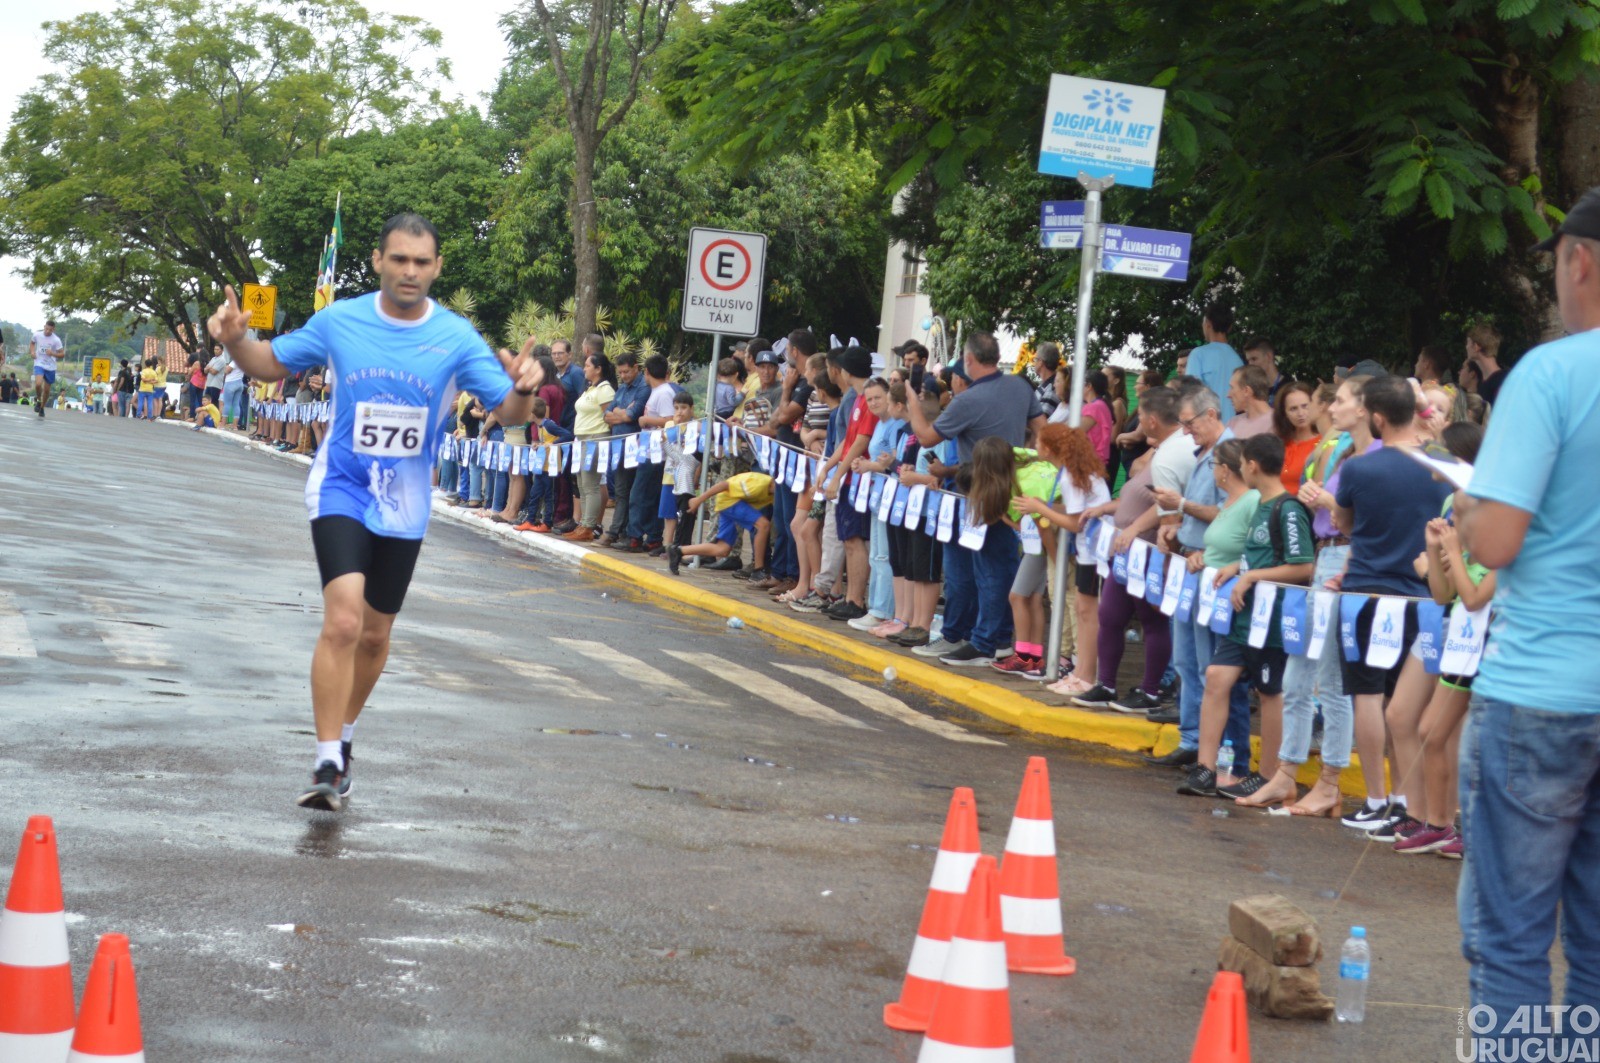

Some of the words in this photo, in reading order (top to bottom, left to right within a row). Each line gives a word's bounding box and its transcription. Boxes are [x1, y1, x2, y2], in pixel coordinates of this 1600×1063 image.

[1052, 111, 1124, 136] DIGIPLAN
[1125, 122, 1155, 140] NET
[1106, 228, 1122, 237] RUA
[1105, 238, 1119, 251] DR.
[1121, 237, 1152, 255] ÁLVARO
[1153, 243, 1182, 258] LEITÃO
[716, 250, 735, 279] E
[690, 295, 753, 311] EXCLUSIVO
[709, 310, 734, 324] TÁXI
[345, 367, 396, 387] QUEBRA
[359, 424, 419, 450] 576
[1287, 511, 1300, 555] HAVAN
[1372, 633, 1400, 649] Banrisul
[1446, 639, 1481, 654] Banrisul
